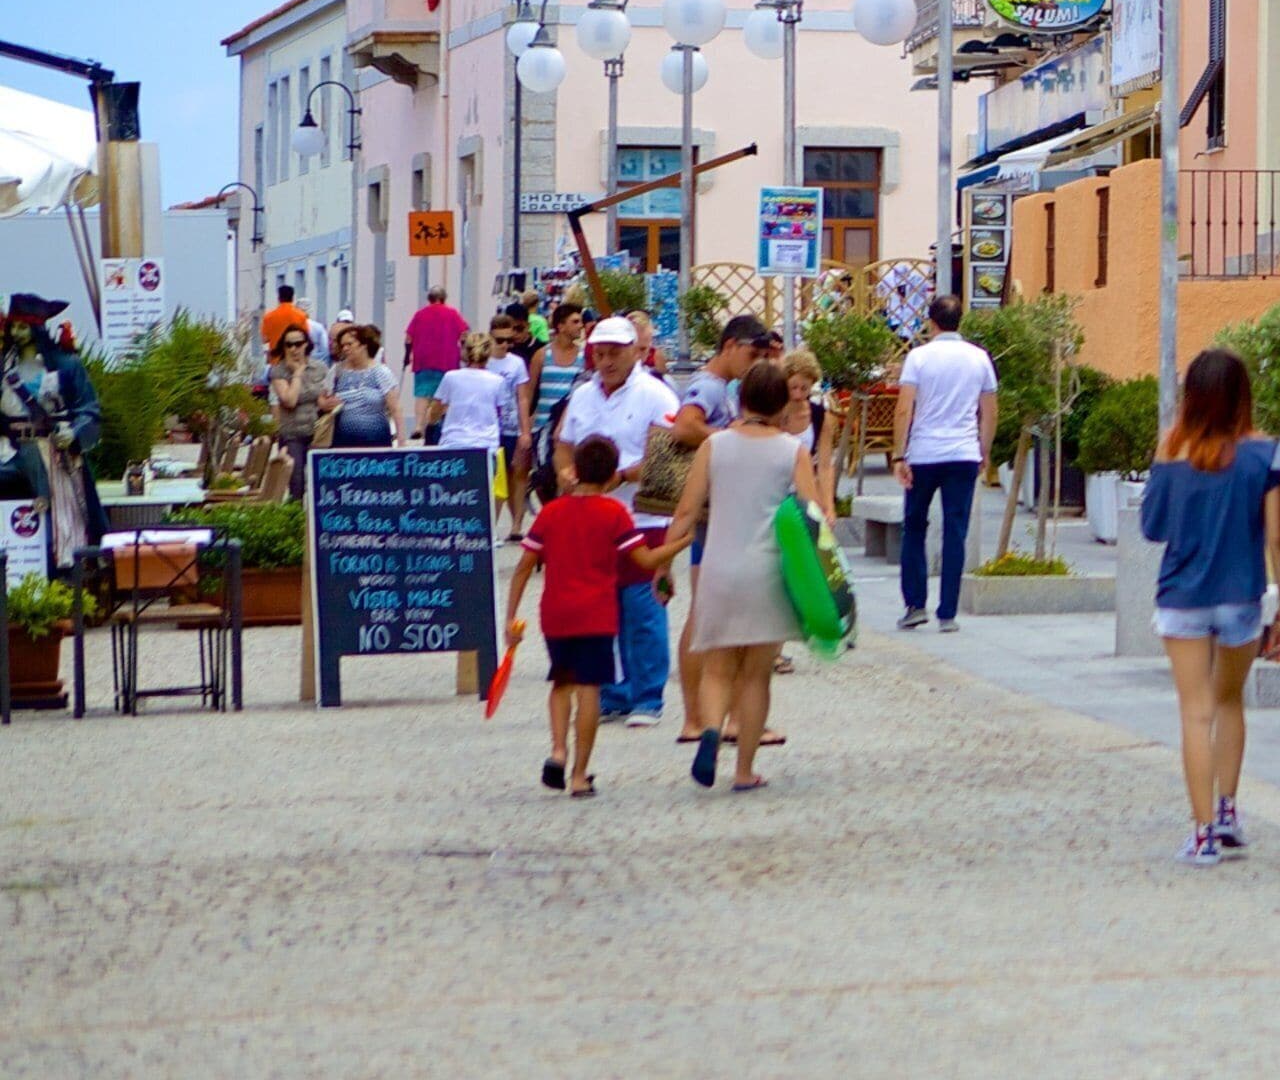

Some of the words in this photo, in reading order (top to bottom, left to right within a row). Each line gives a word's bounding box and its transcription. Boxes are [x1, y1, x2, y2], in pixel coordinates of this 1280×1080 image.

[1013, 4, 1079, 23] SALUMI
[529, 193, 586, 202] HOTEL
[529, 203, 548, 211] DA
[329, 551, 382, 574] FORNO
[349, 587, 402, 610] VISTA
[359, 624, 391, 652] NO
[400, 623, 460, 650] STOP
